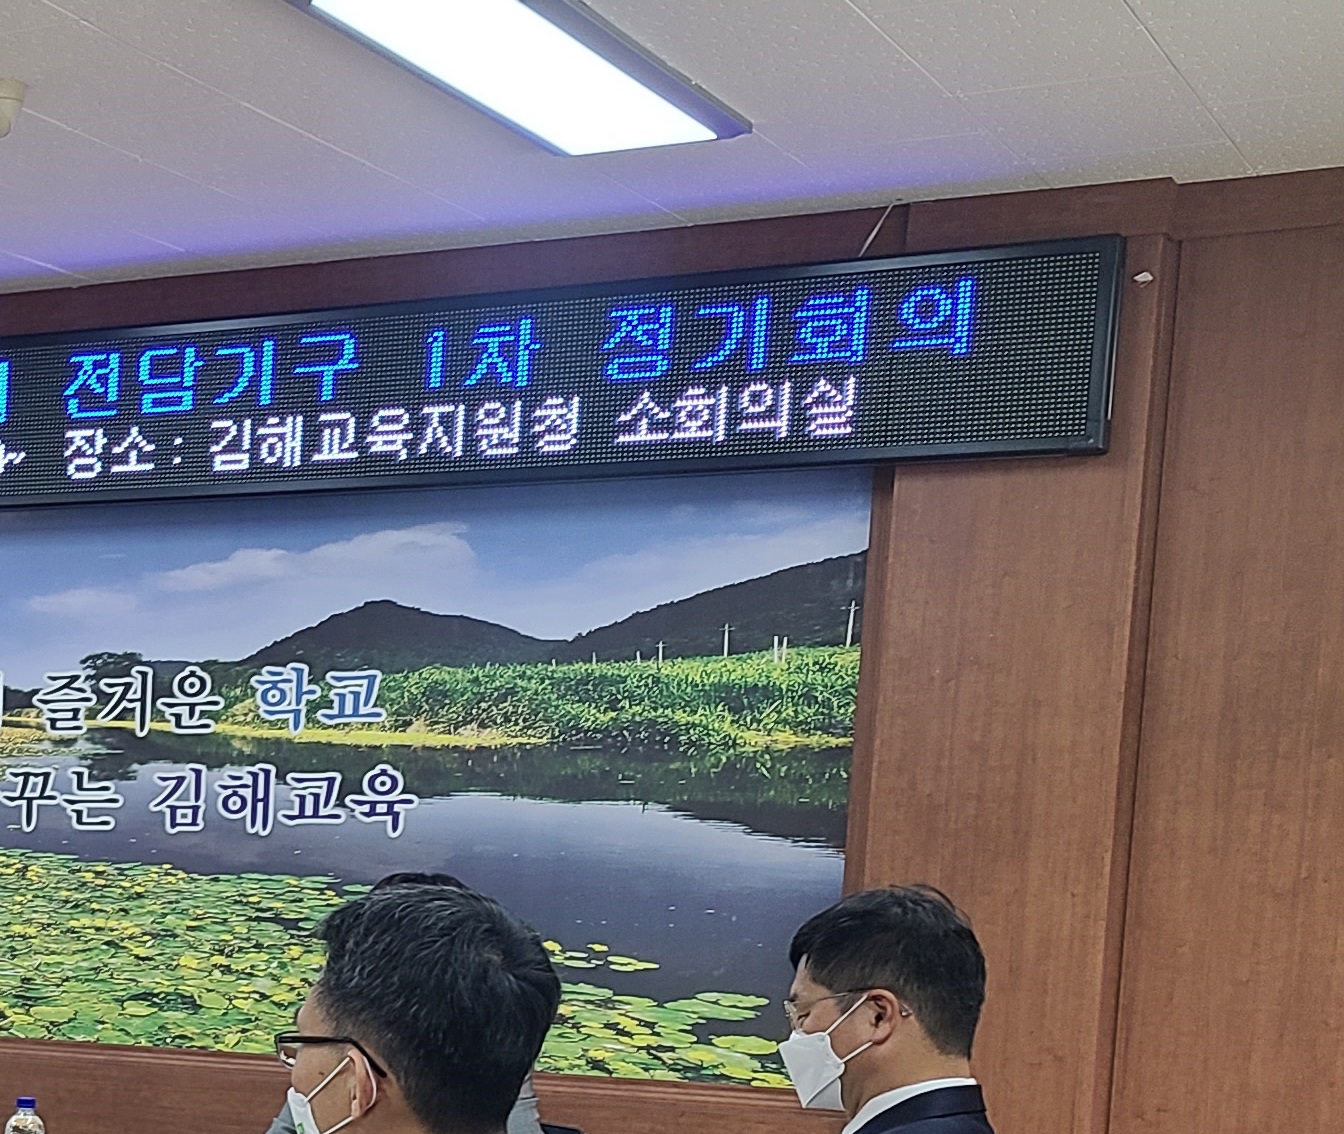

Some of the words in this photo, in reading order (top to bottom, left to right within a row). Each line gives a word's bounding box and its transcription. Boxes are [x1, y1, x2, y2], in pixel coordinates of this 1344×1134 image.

[62, 330, 360, 419] 전담기구
[424, 315, 543, 390] 1차
[600, 276, 977, 381] 정기회의
[63, 425, 157, 480] 장소
[210, 393, 581, 473] 김해교육지원청
[613, 373, 858, 445] 소회의실
[32, 667, 223, 737] 즐거운
[252, 663, 385, 734] 학교
[149, 764, 418, 837] 김해교육
